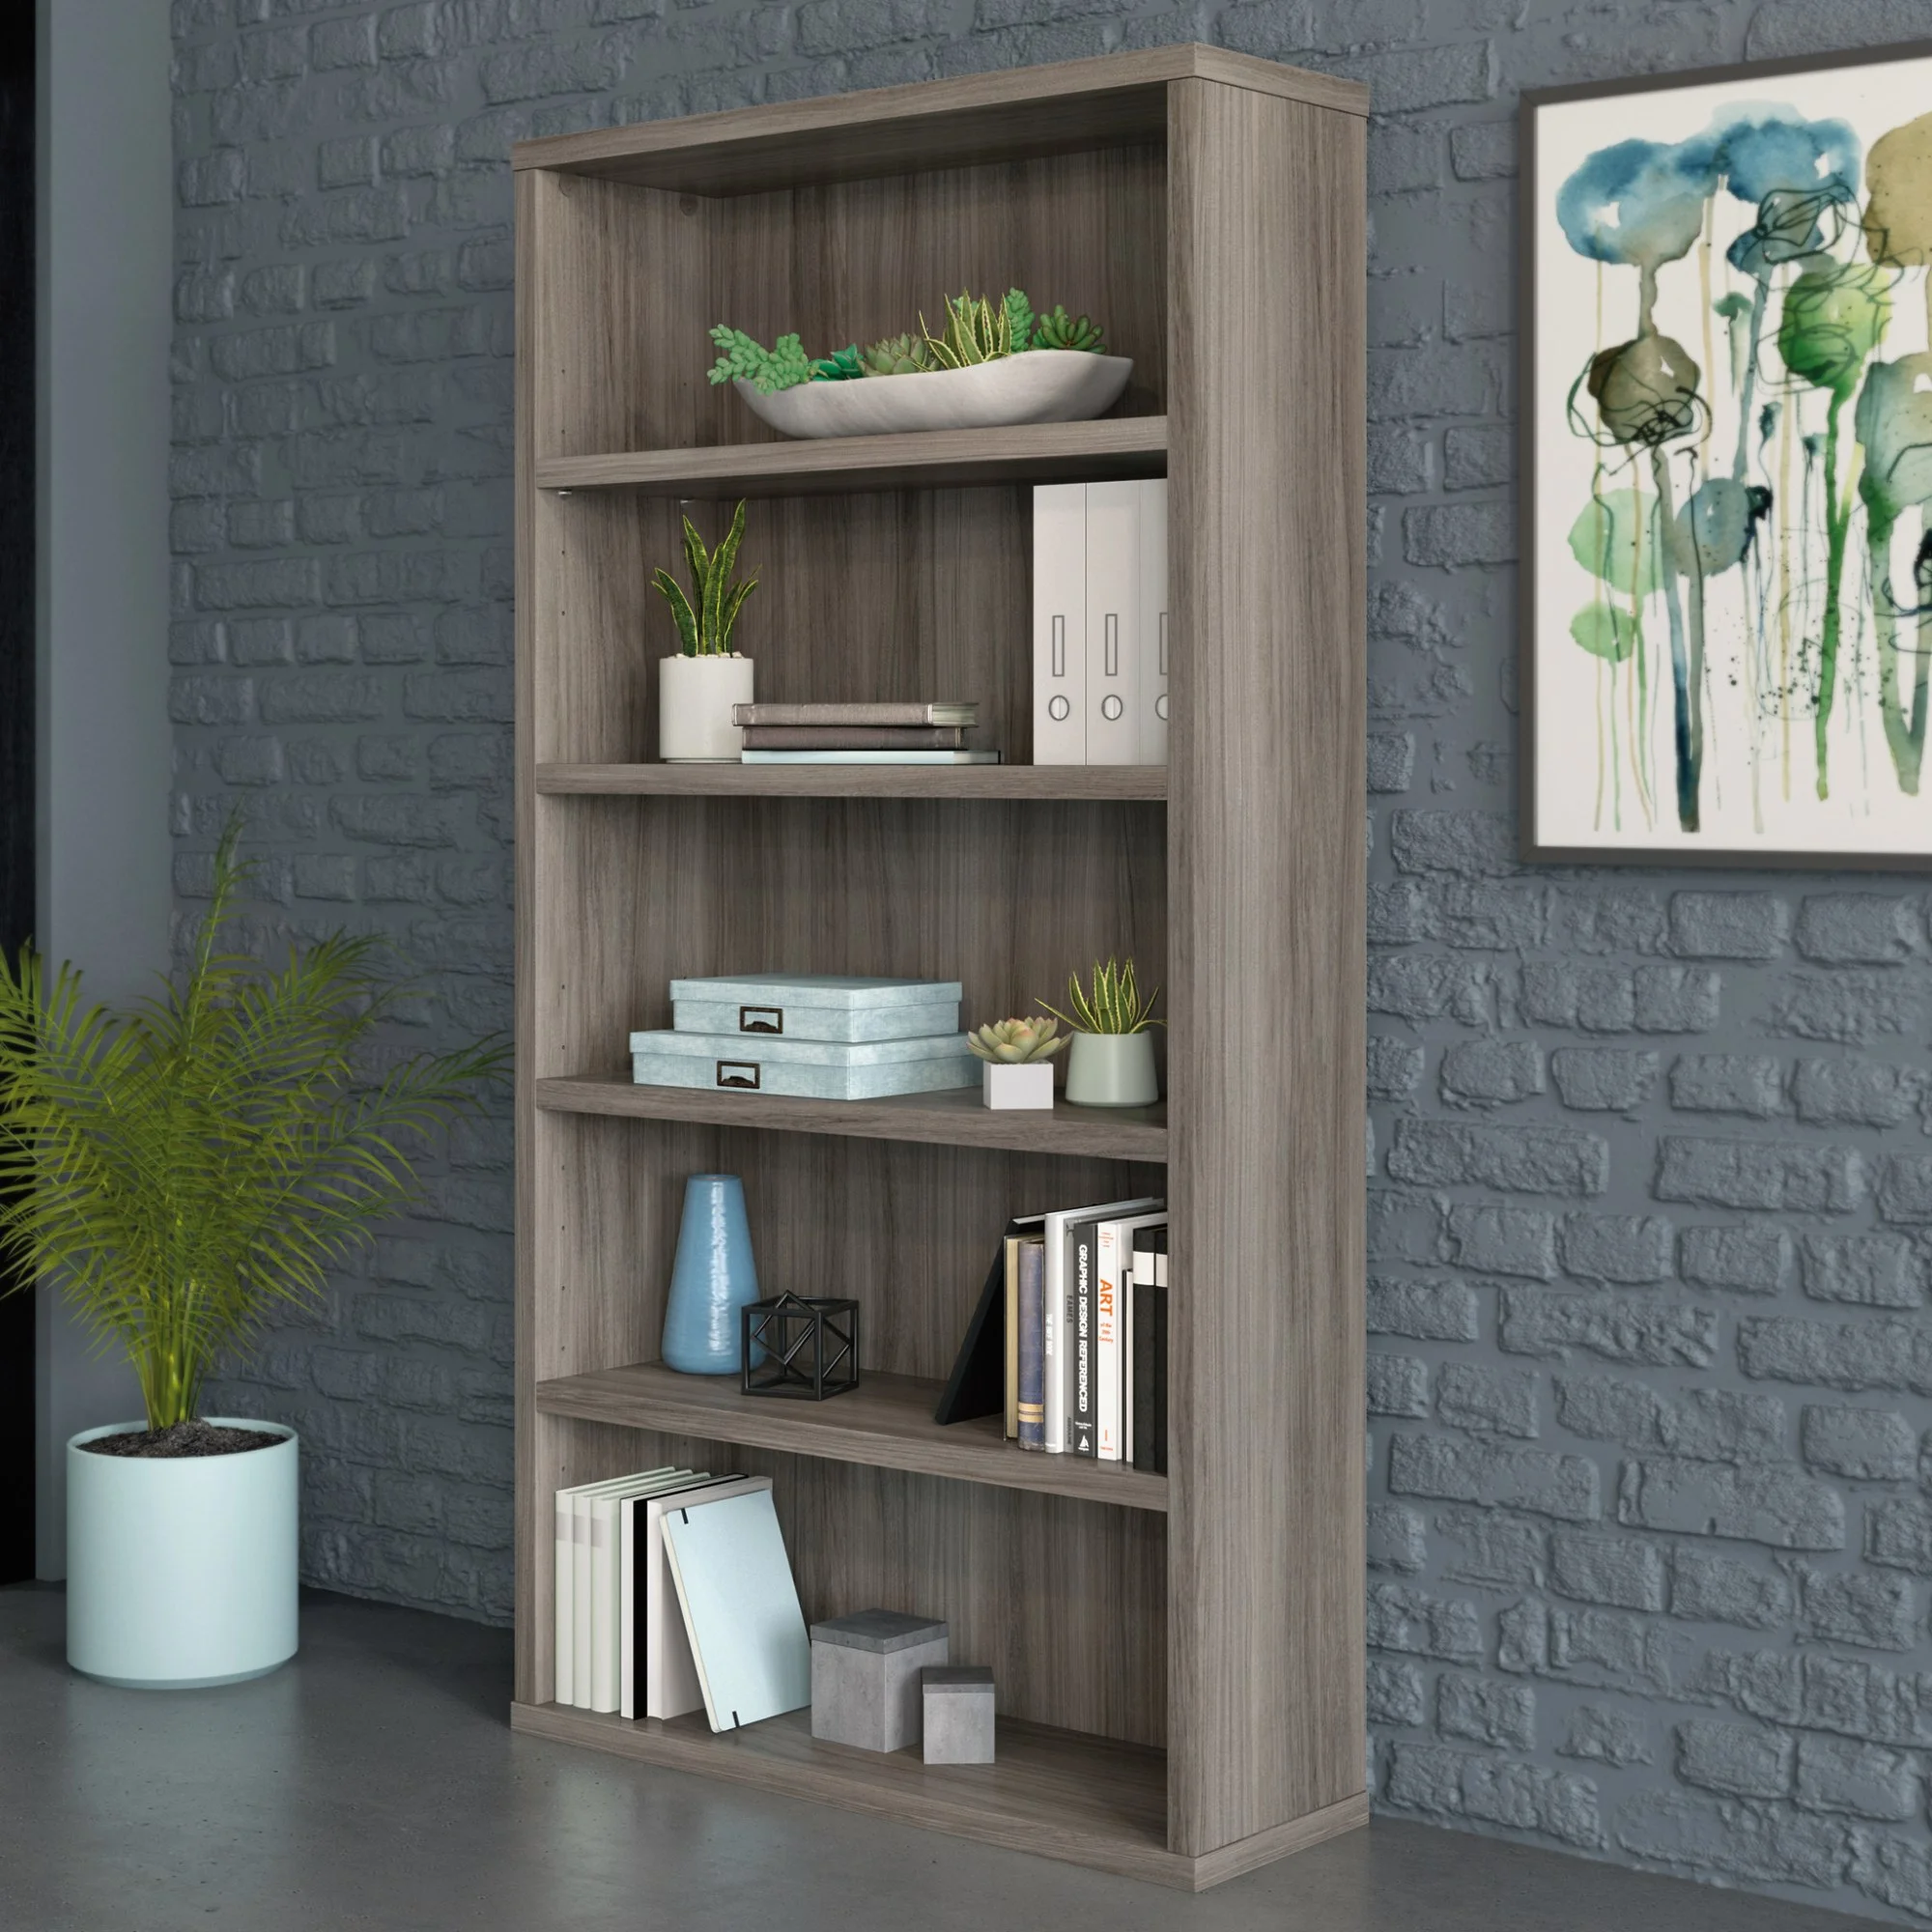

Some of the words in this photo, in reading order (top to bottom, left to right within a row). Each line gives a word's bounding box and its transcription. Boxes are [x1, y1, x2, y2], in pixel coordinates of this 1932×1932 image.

[1079, 1244, 1088, 1294] GRAPHIC
[1079, 1296, 1088, 1337] DESIGN
[1100, 1279, 1113, 1317] ART
[1079, 1340, 1088, 1412] REFERENCED
